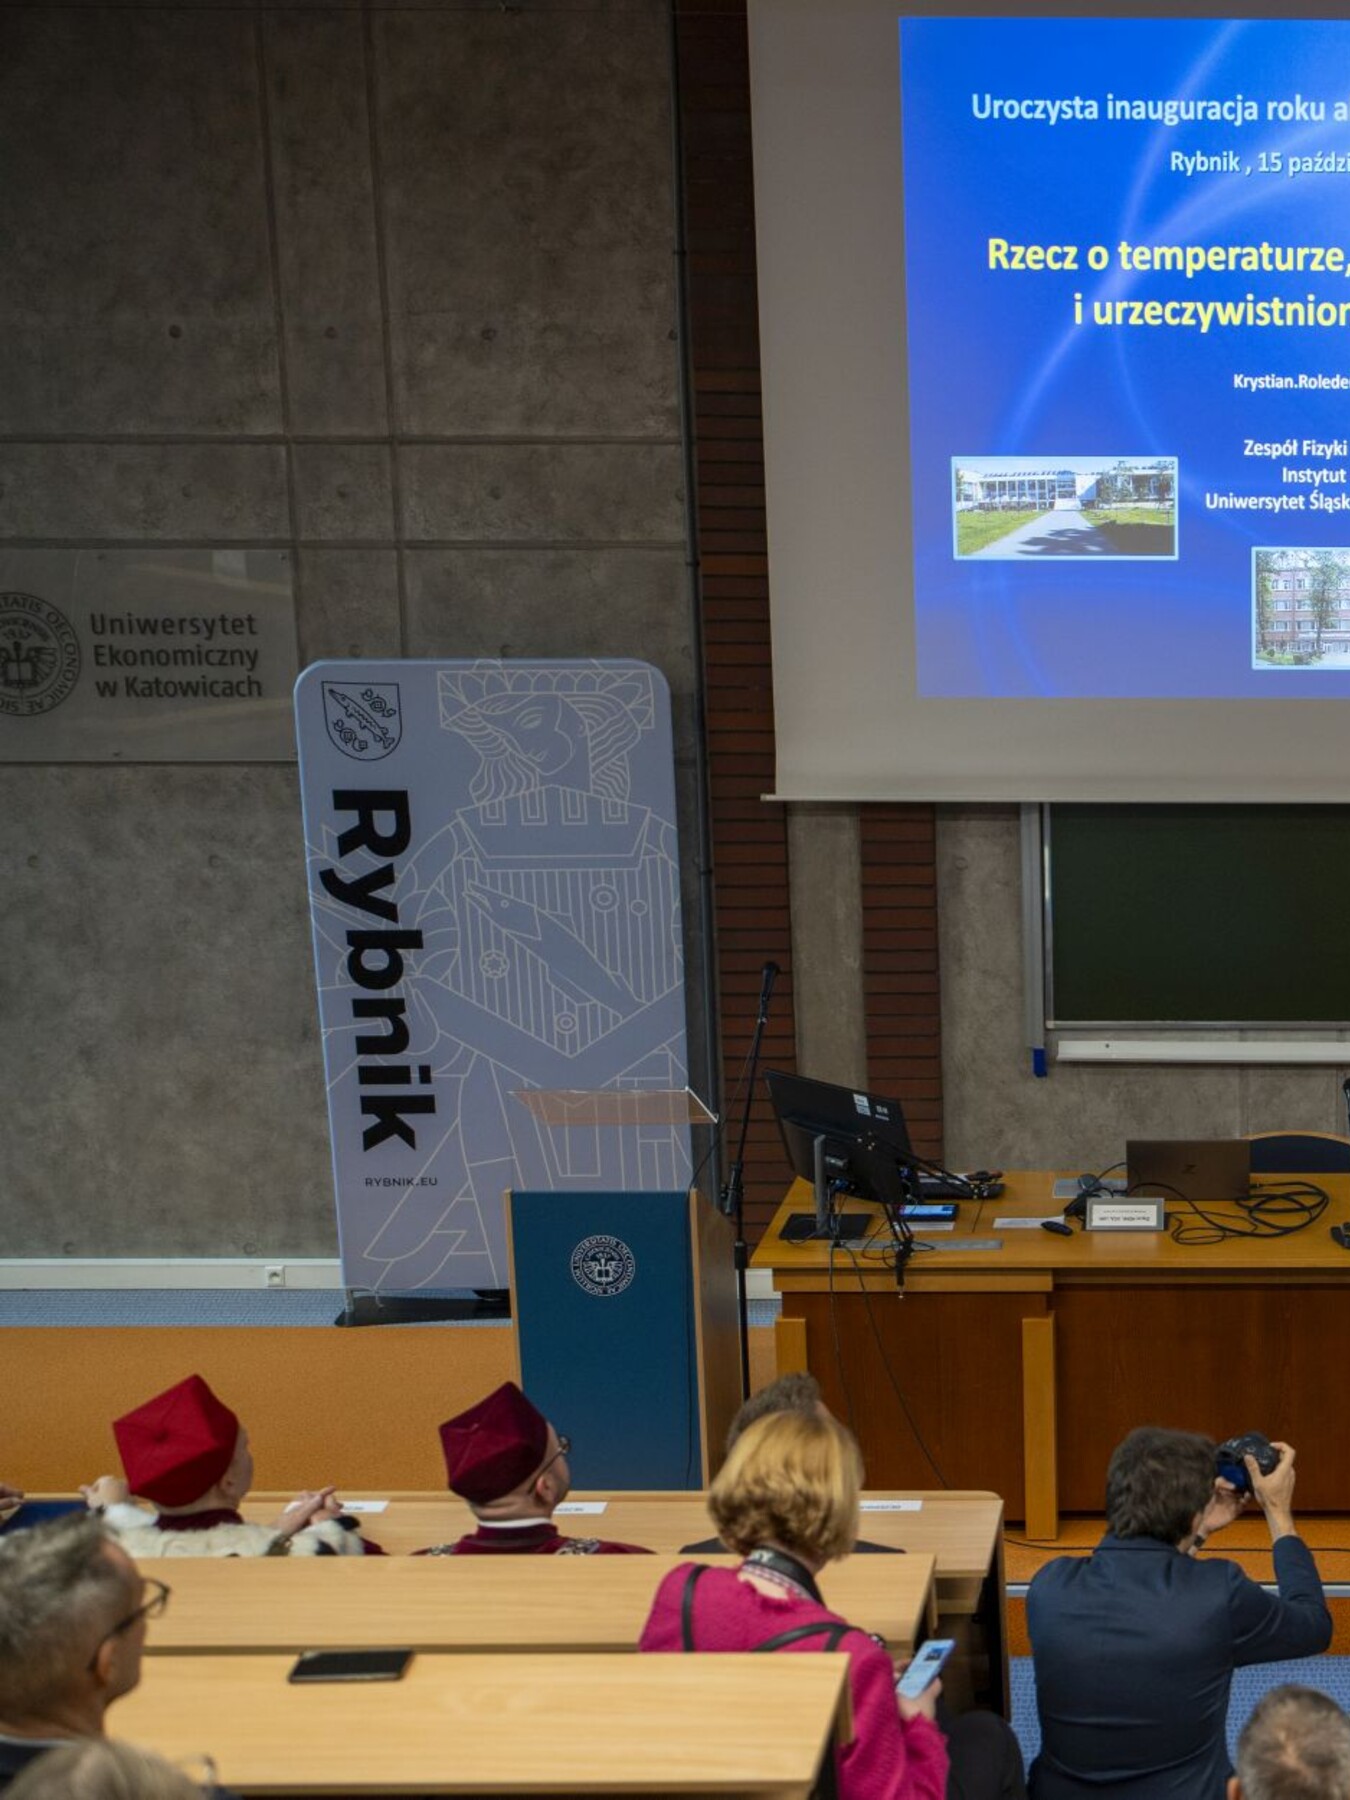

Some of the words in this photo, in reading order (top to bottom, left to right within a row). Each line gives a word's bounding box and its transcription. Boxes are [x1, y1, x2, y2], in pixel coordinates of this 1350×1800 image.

[973, 94, 1098, 125] Uroczysta
[1107, 94, 1258, 126] inauguracja
[1267, 95, 1325, 121] roku
[1171, 151, 1240, 175] Rybnik
[1258, 151, 1281, 171] 15
[989, 238, 1078, 270] Rzecz
[1088, 246, 1109, 270] o
[1074, 293, 1082, 325] i
[1244, 439, 1298, 459] Zespół
[1303, 440, 1347, 459] Fizyki
[1283, 467, 1346, 487] Instytut
[1206, 493, 1305, 513] Uniwersytet
[90, 613, 257, 640] Uniwersytet
[93, 644, 258, 672] Ekonomiczny
[95, 681, 118, 697] w
[124, 675, 262, 698] Katowicach
[319, 790, 435, 1151] Rybnik
[365, 1177, 437, 1187] RYBNIK.EU
